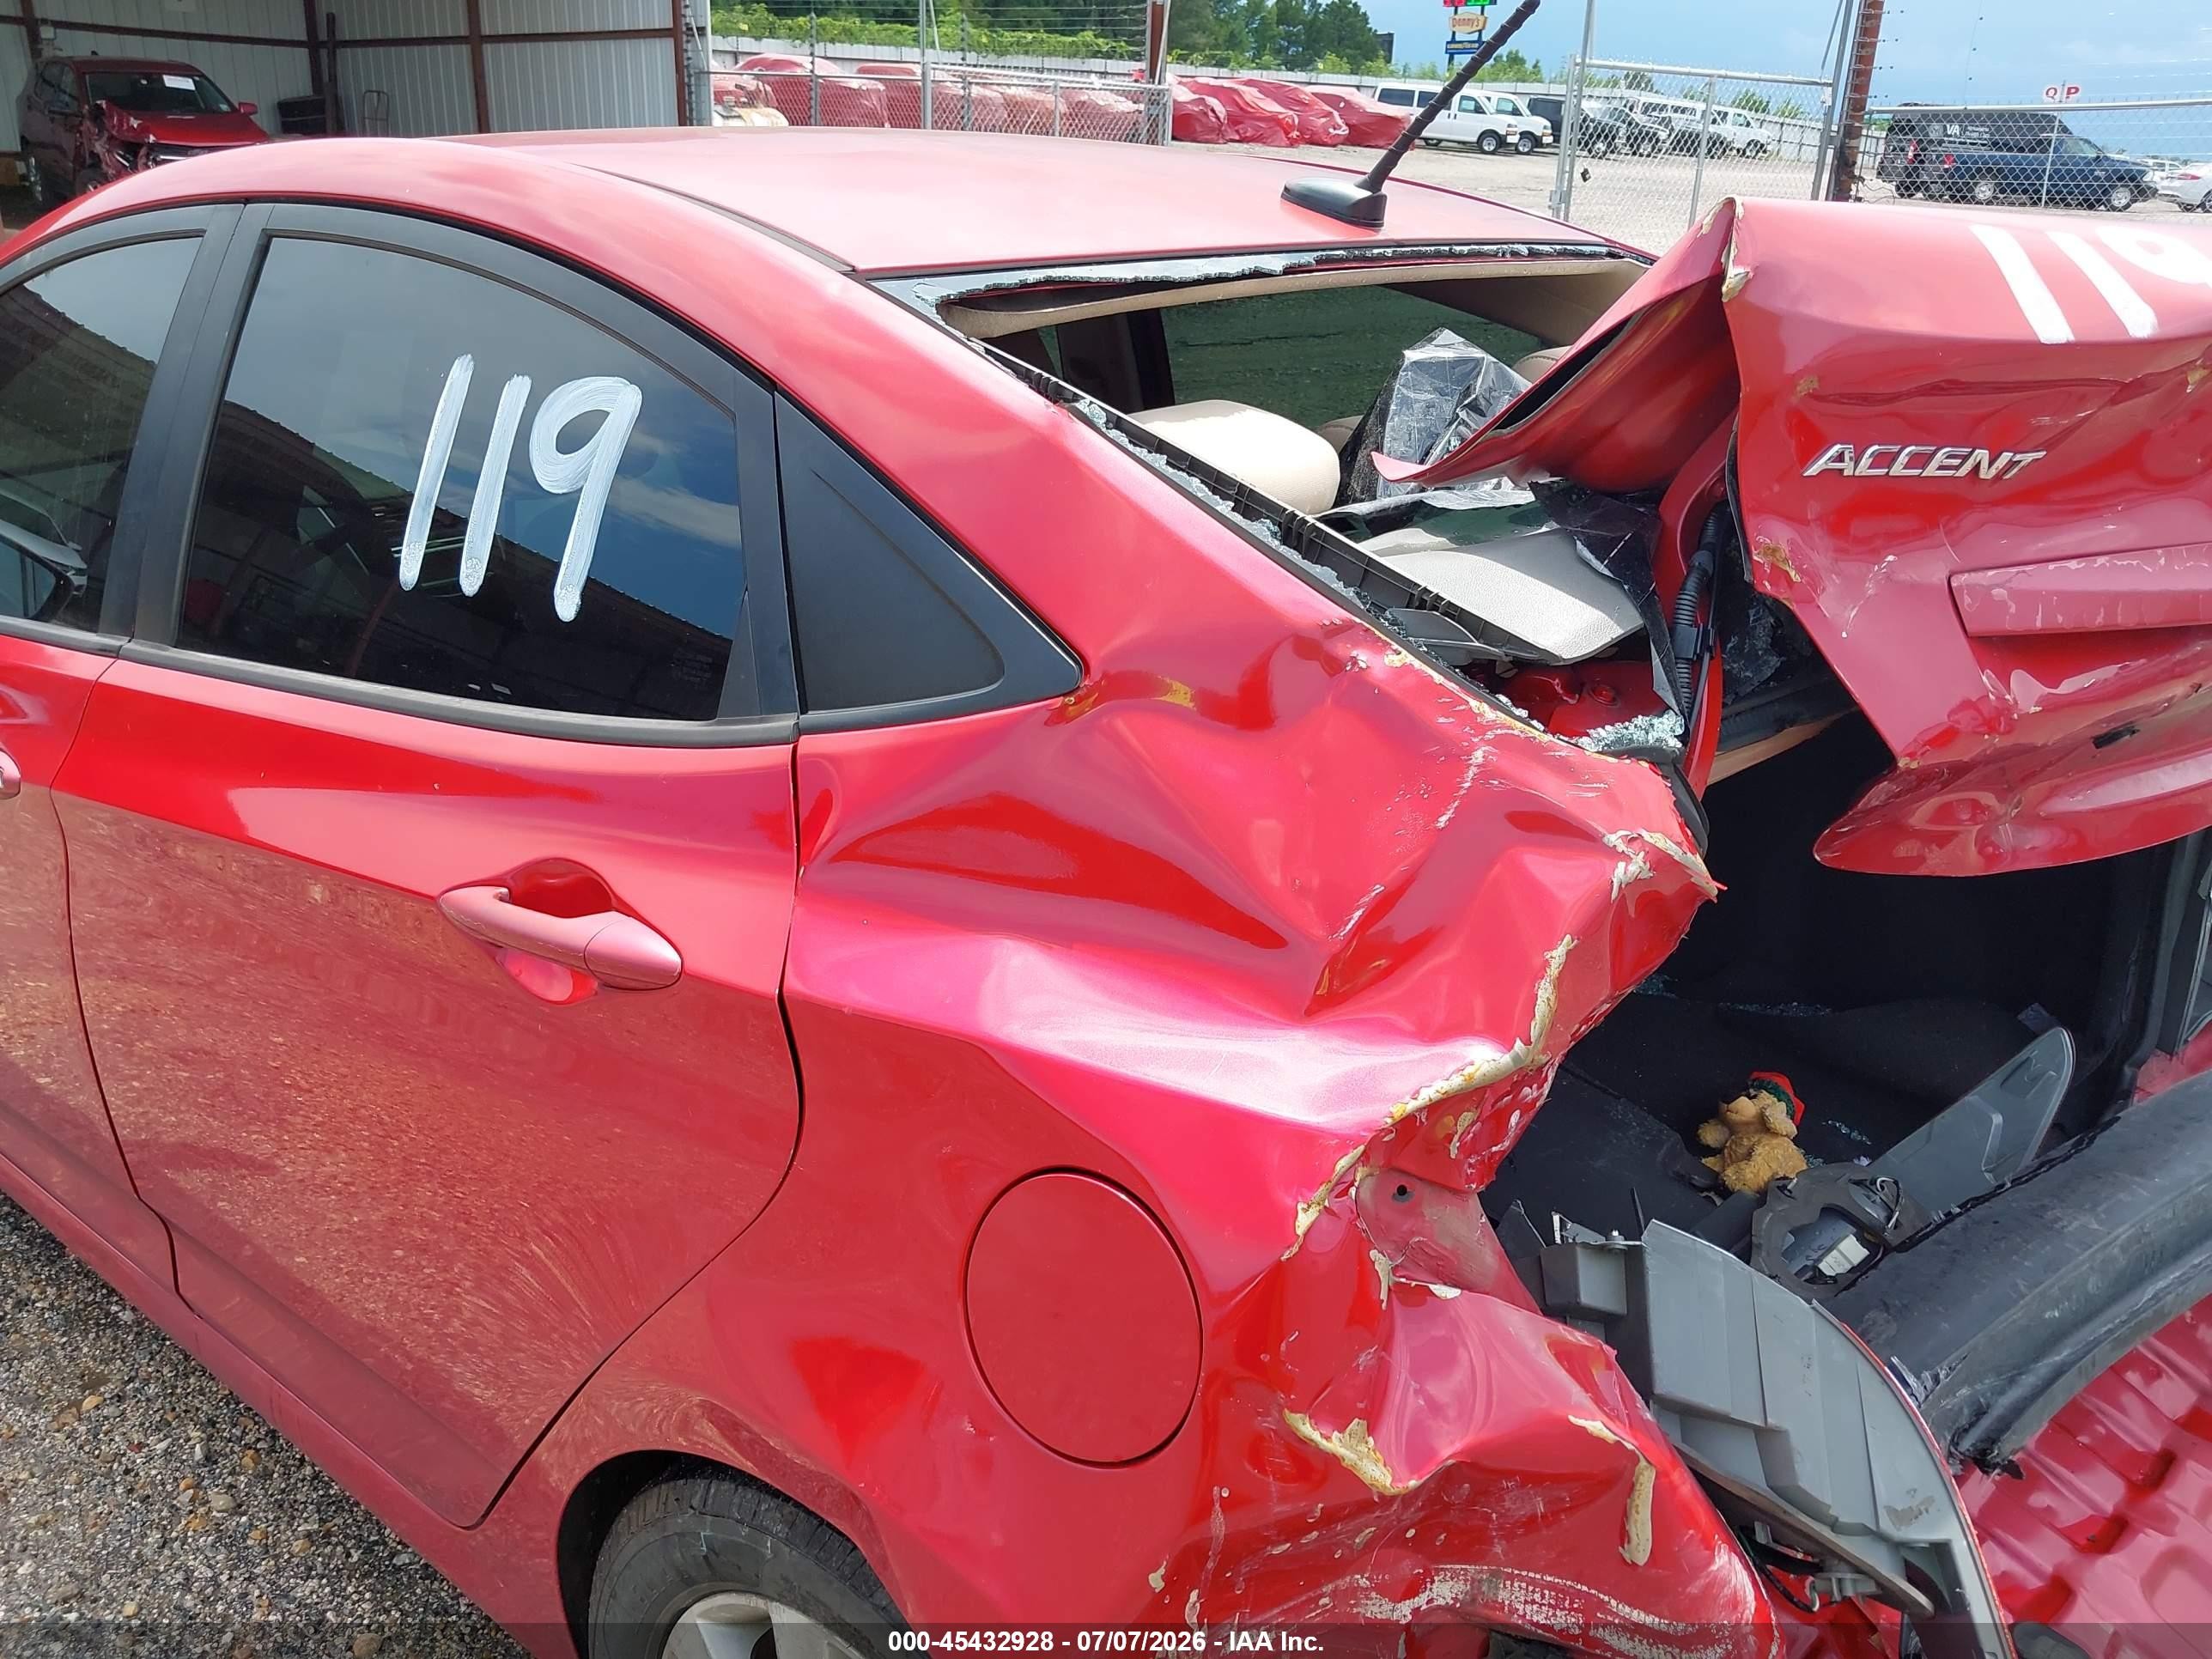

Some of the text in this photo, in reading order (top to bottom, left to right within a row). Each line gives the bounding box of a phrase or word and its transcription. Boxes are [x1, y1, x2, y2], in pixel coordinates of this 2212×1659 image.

[2065, 87, 2080, 99] P
[1802, 443, 2048, 480] ACCENT
[398, 353, 643, 623] 119
